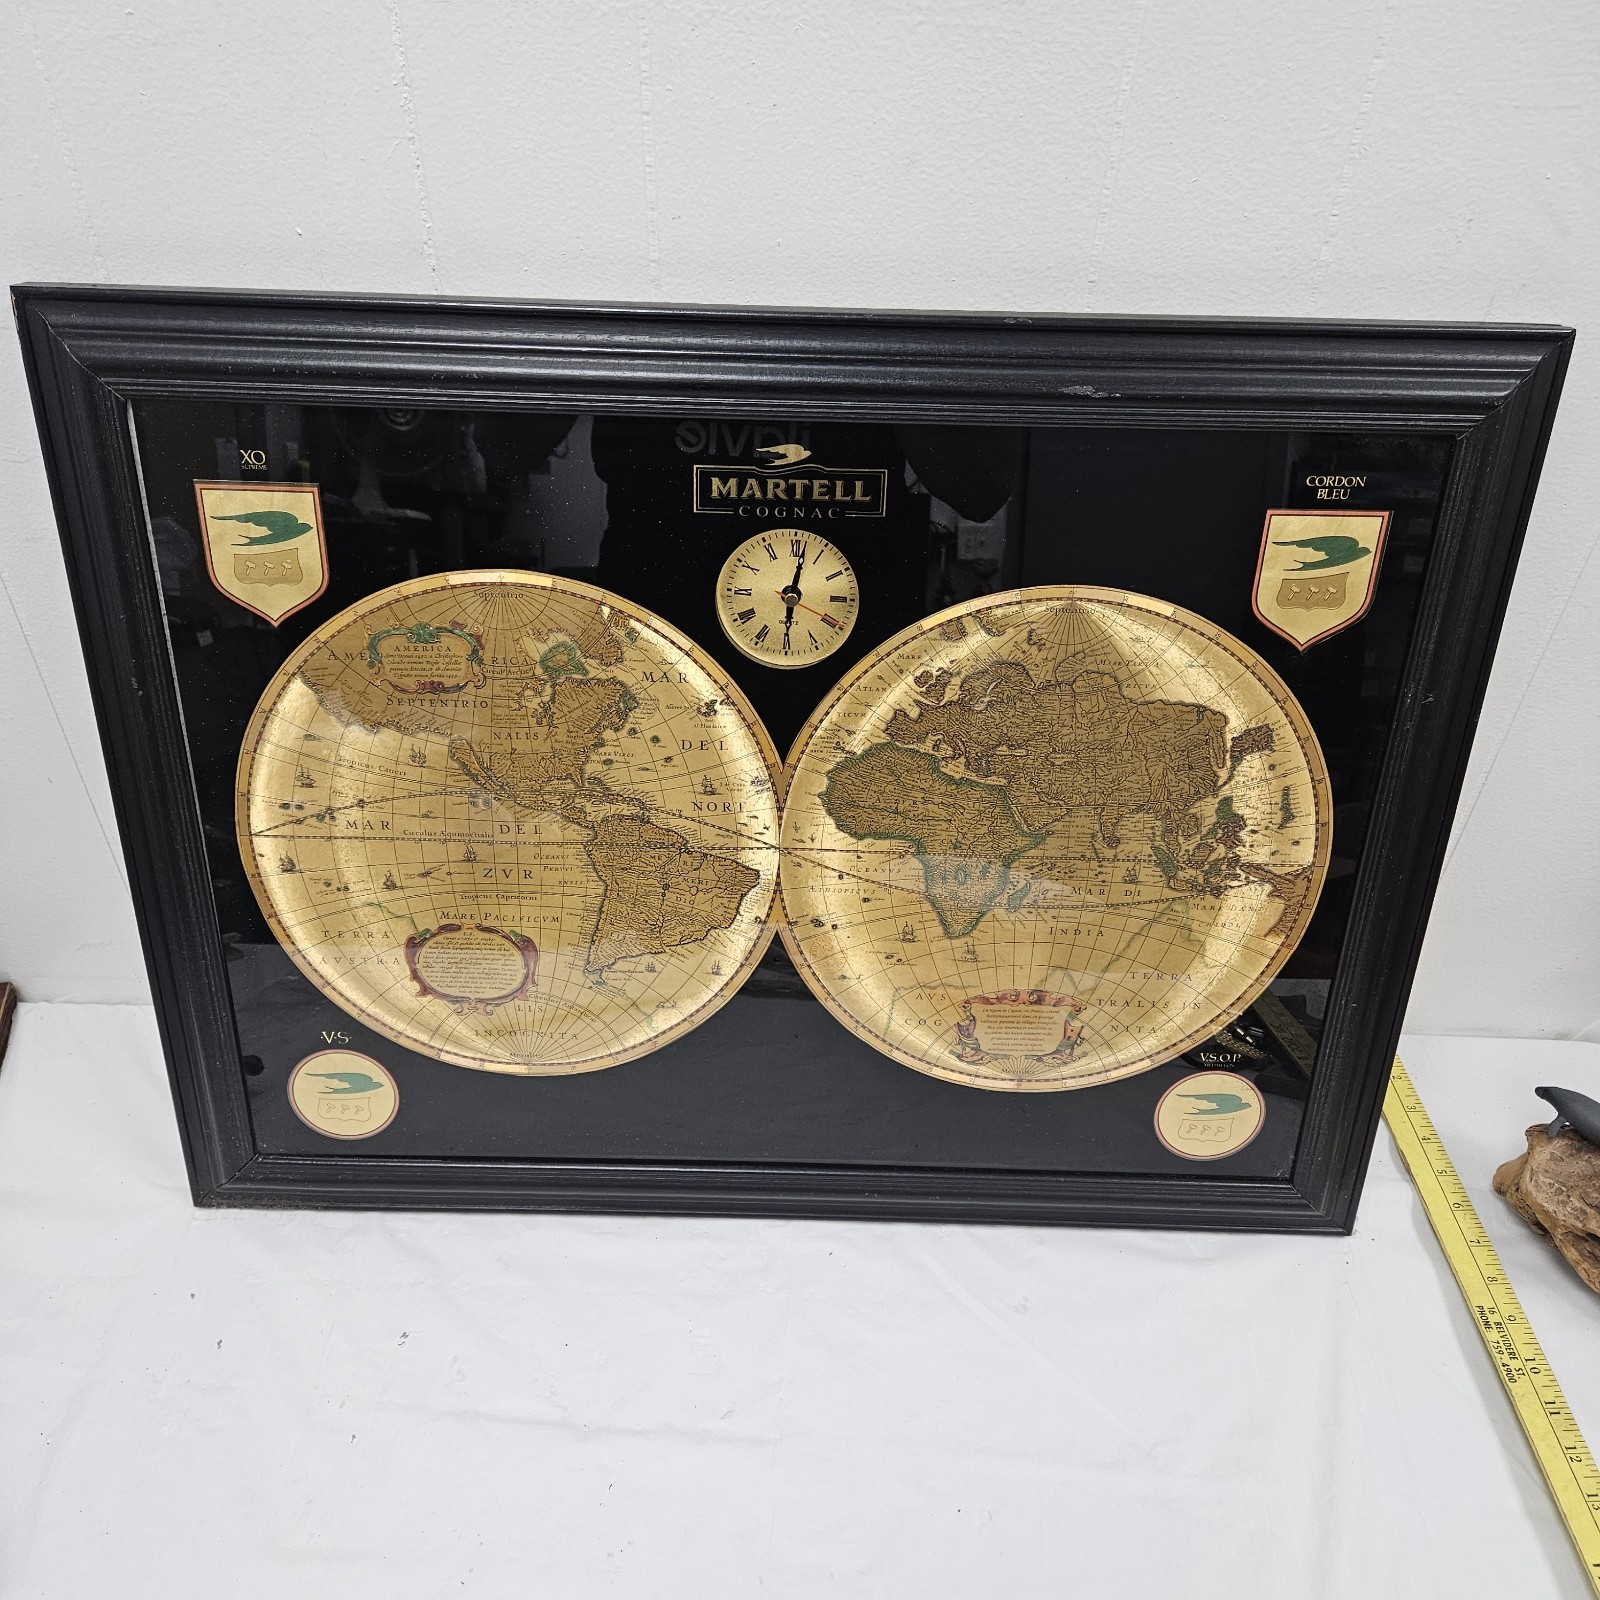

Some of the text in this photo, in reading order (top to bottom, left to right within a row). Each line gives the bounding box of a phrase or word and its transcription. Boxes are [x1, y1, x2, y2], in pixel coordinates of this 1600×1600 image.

[239, 449, 266, 465] XO
[1305, 475, 1367, 488] CORDON
[709, 476, 874, 502] MARTELL
[1316, 488, 1351, 500] BLEU
[738, 505, 841, 519] COGNAC
[640, 671, 690, 684] MAR
[386, 694, 489, 709] SEPTENTRIO
[493, 731, 539, 741] NALIS
[681, 739, 730, 751] DEL
[345, 819, 392, 830] MAR
[499, 824, 543, 835] DEL
[482, 868, 535, 880] ZVR
[1070, 886, 1141, 897] MAR DI
[439, 911, 561, 923] MARE PACIFICVM
[322, 930, 391, 939] TERRA
[1049, 927, 1105, 937] INDIA
[1129, 971, 1193, 982] TERRA
[1475, 1305, 1494, 1333] PHONE:
[1504, 1314, 1517, 1322] 9
[1486, 1306, 1498, 1315] 16
[1493, 1321, 1519, 1361] BELVIDERE
